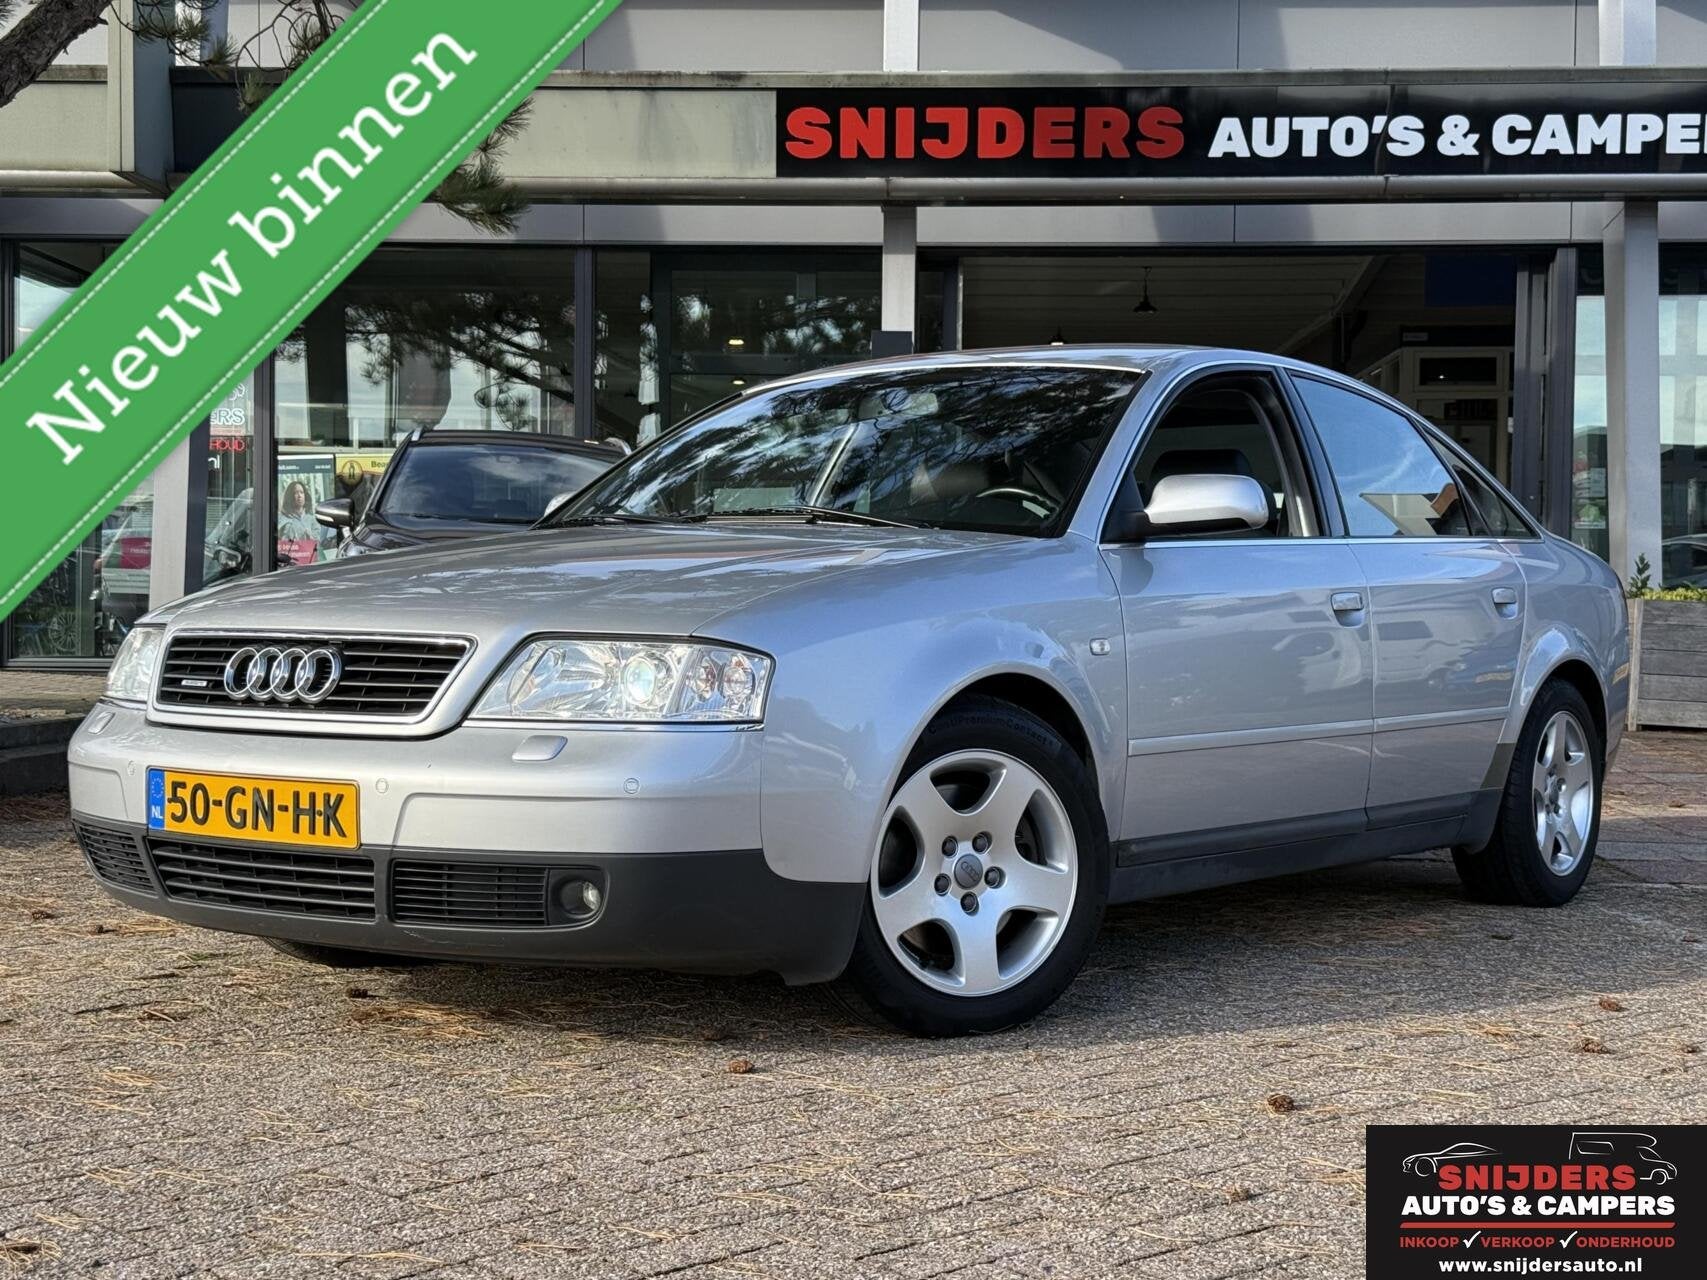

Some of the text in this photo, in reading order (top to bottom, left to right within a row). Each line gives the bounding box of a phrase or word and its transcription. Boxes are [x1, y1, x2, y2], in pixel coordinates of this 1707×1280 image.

[785, 106, 1707, 159] SNIJDERS AUTO'S & CAMPE
[151, 805, 163, 819] NL
[167, 780, 348, 838] 50-GN-HK
